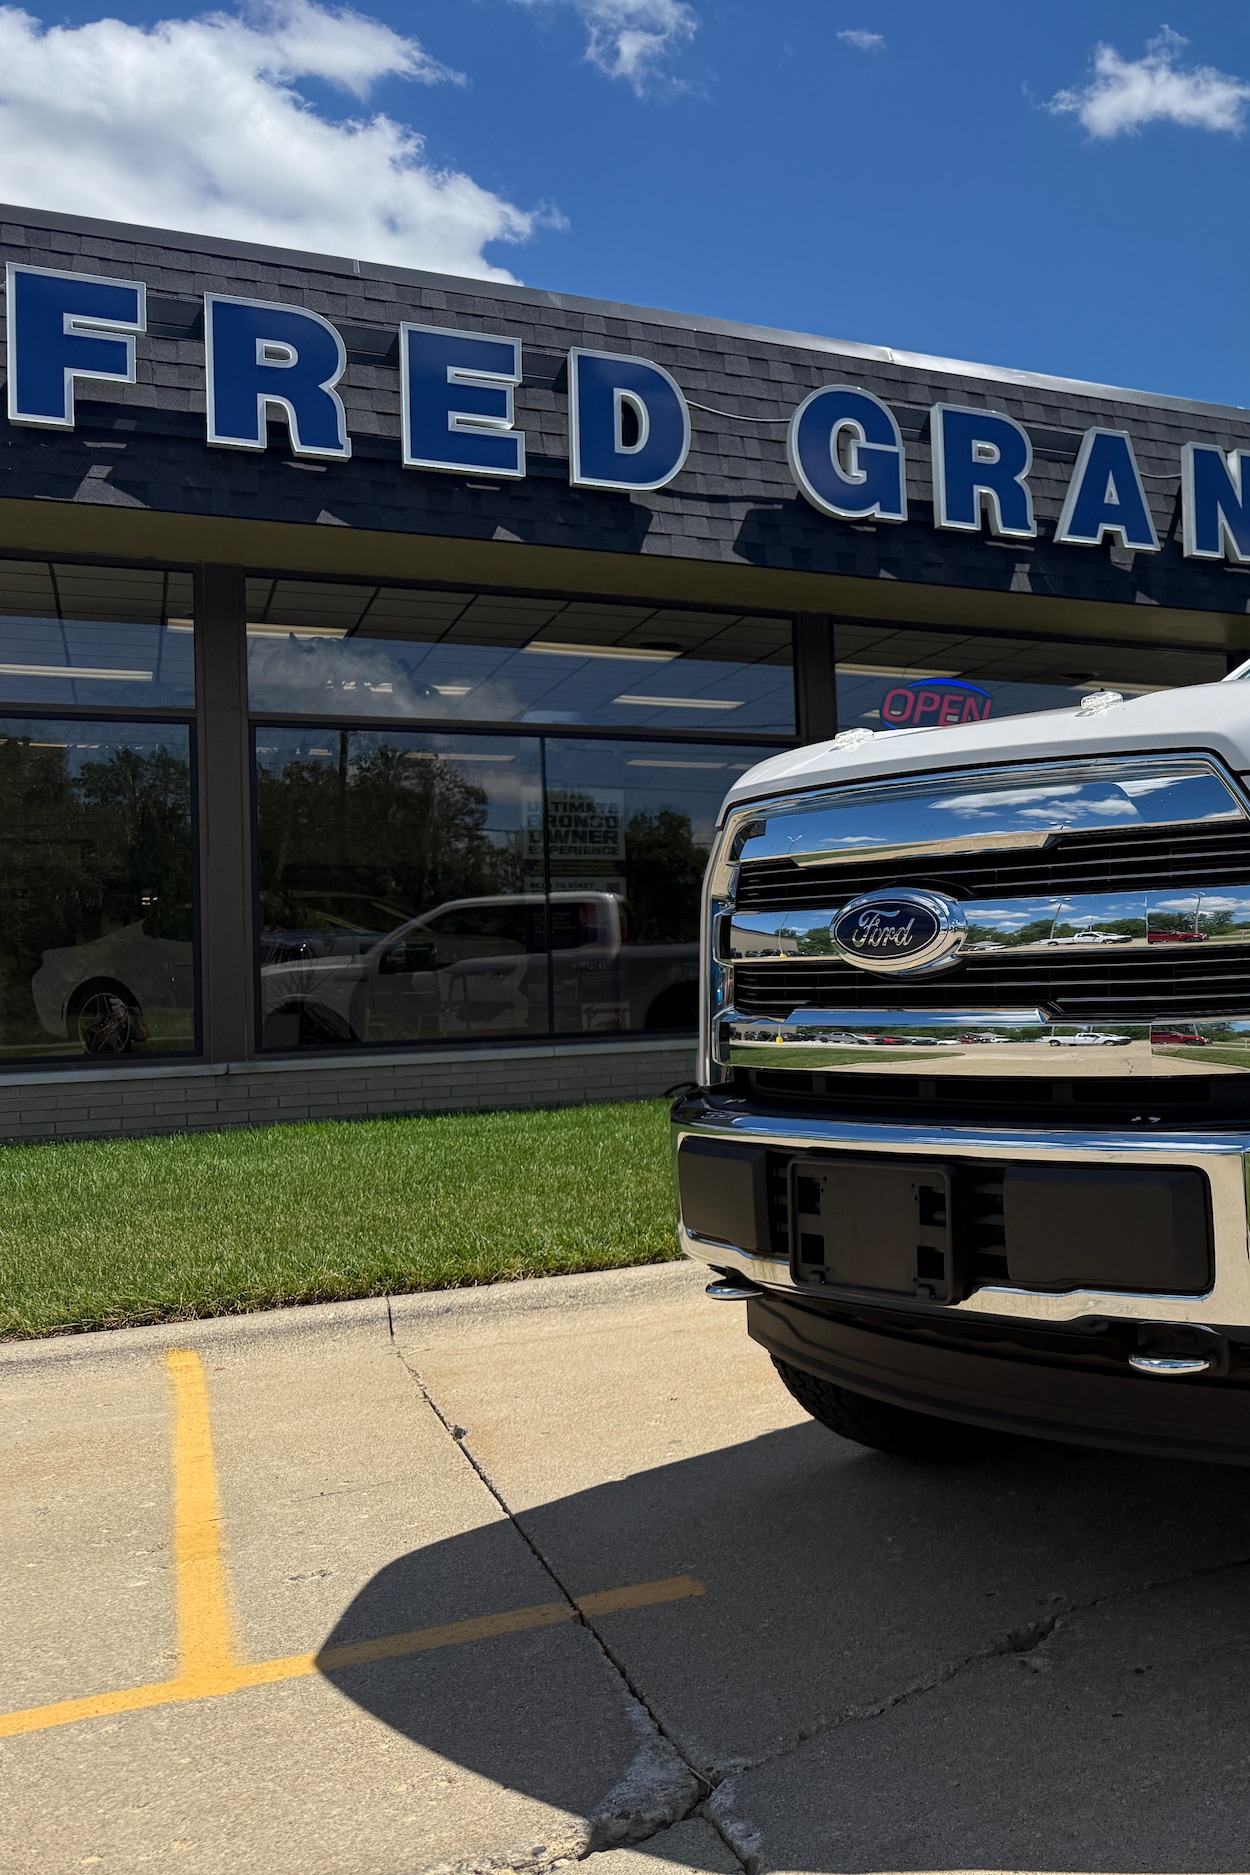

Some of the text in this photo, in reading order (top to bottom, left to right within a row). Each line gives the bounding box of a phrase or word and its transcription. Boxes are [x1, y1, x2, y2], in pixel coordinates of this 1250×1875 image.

[6, 261, 691, 492] FRED
[882, 688, 992, 727] OPEN
[527, 801, 618, 814] UTIMATE
[528, 829, 619, 844] OWNER
[851, 909, 916, 948] Ford
